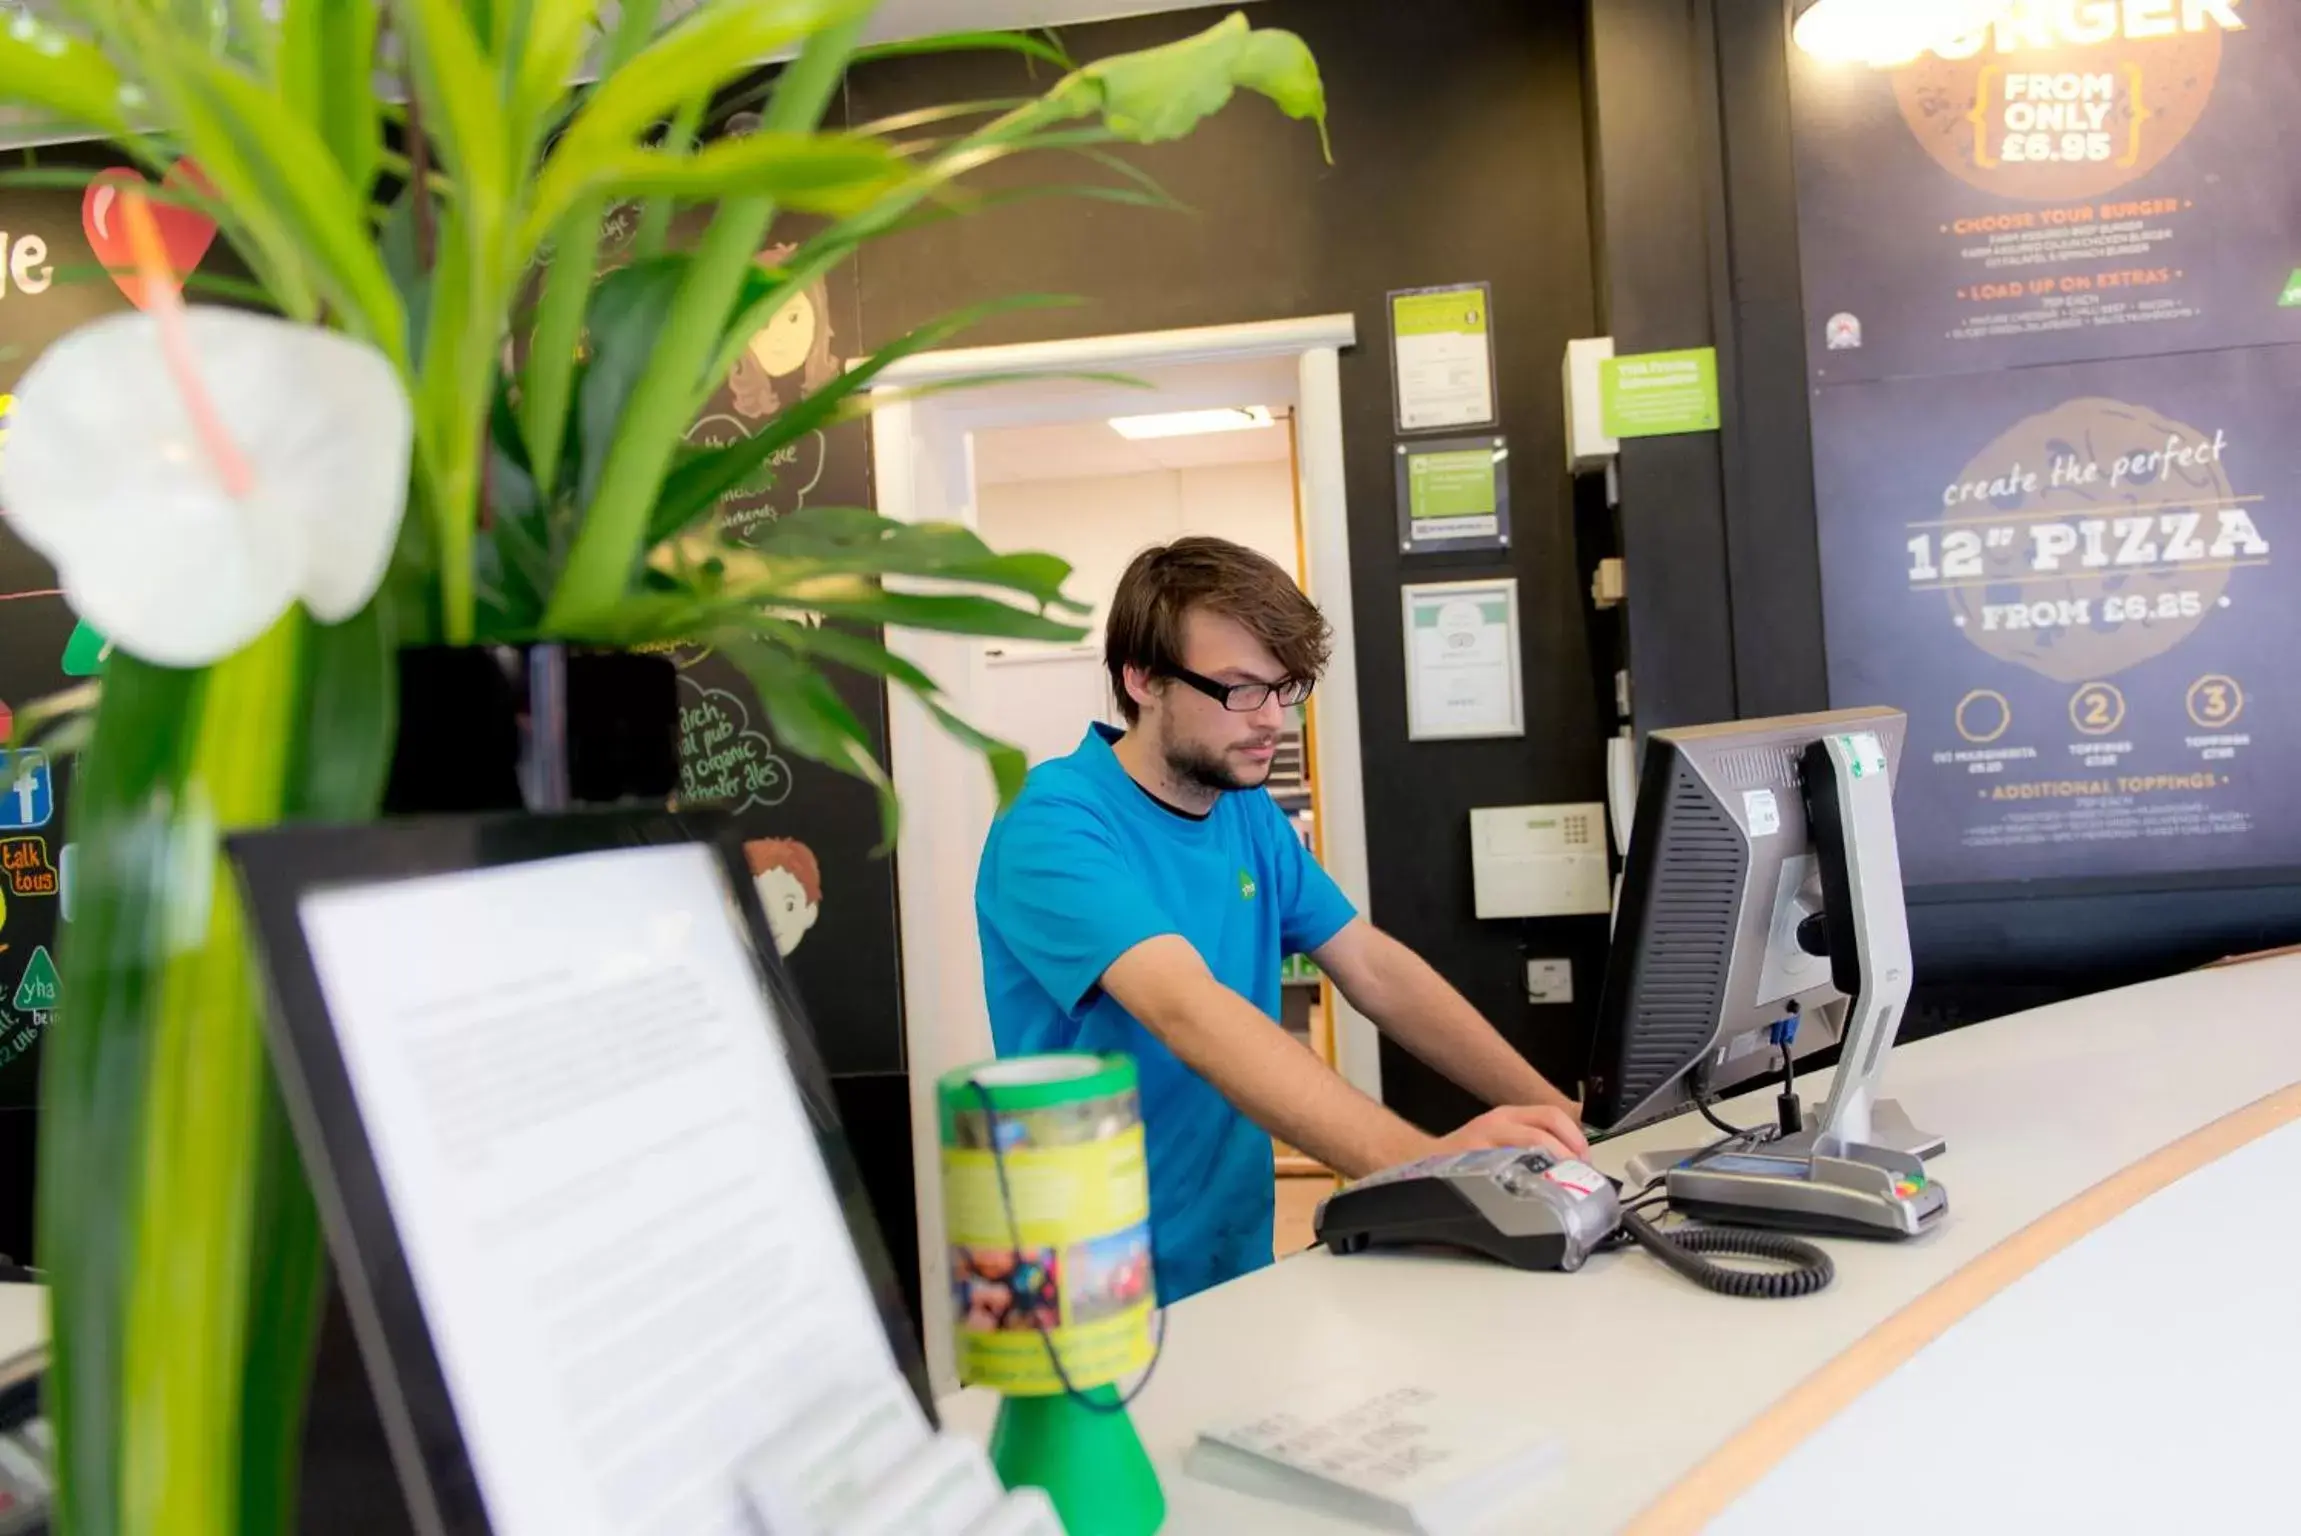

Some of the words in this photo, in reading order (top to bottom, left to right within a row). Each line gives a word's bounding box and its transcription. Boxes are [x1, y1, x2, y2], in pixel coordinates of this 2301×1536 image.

[2003, 73, 2114, 101] FROM
[2003, 102, 2112, 131] ONLY
[2000, 133, 2112, 163] £6.95
[1953, 213, 2035, 234] CHOOSE
[2040, 206, 2095, 224] YOUR
[2101, 198, 2178, 218] BURGER
[1969, 282, 2023, 301] LOAD
[2029, 279, 2056, 296] UP
[2060, 276, 2091, 293] ON
[2097, 267, 2170, 288] EXTRAS
[1942, 463, 2037, 505] create
[2051, 454, 2098, 486] the
[2110, 429, 2228, 488] perfect
[2029, 508, 2270, 571] PIZZA
[1982, 599, 2090, 631] FROM
[2103, 591, 2202, 623] £6.25
[2084, 694, 2109, 724] 2
[2202, 684, 2227, 717] 3
[703, 722, 734, 758] pub
[696, 740, 758, 785] organic
[743, 760, 780, 792] ales
[1991, 778, 2109, 801] ADDITIONAL
[2116, 772, 2217, 795] TOPPINGS
[3, 843, 41, 870] talk
[23, 975, 56, 1005] yha
